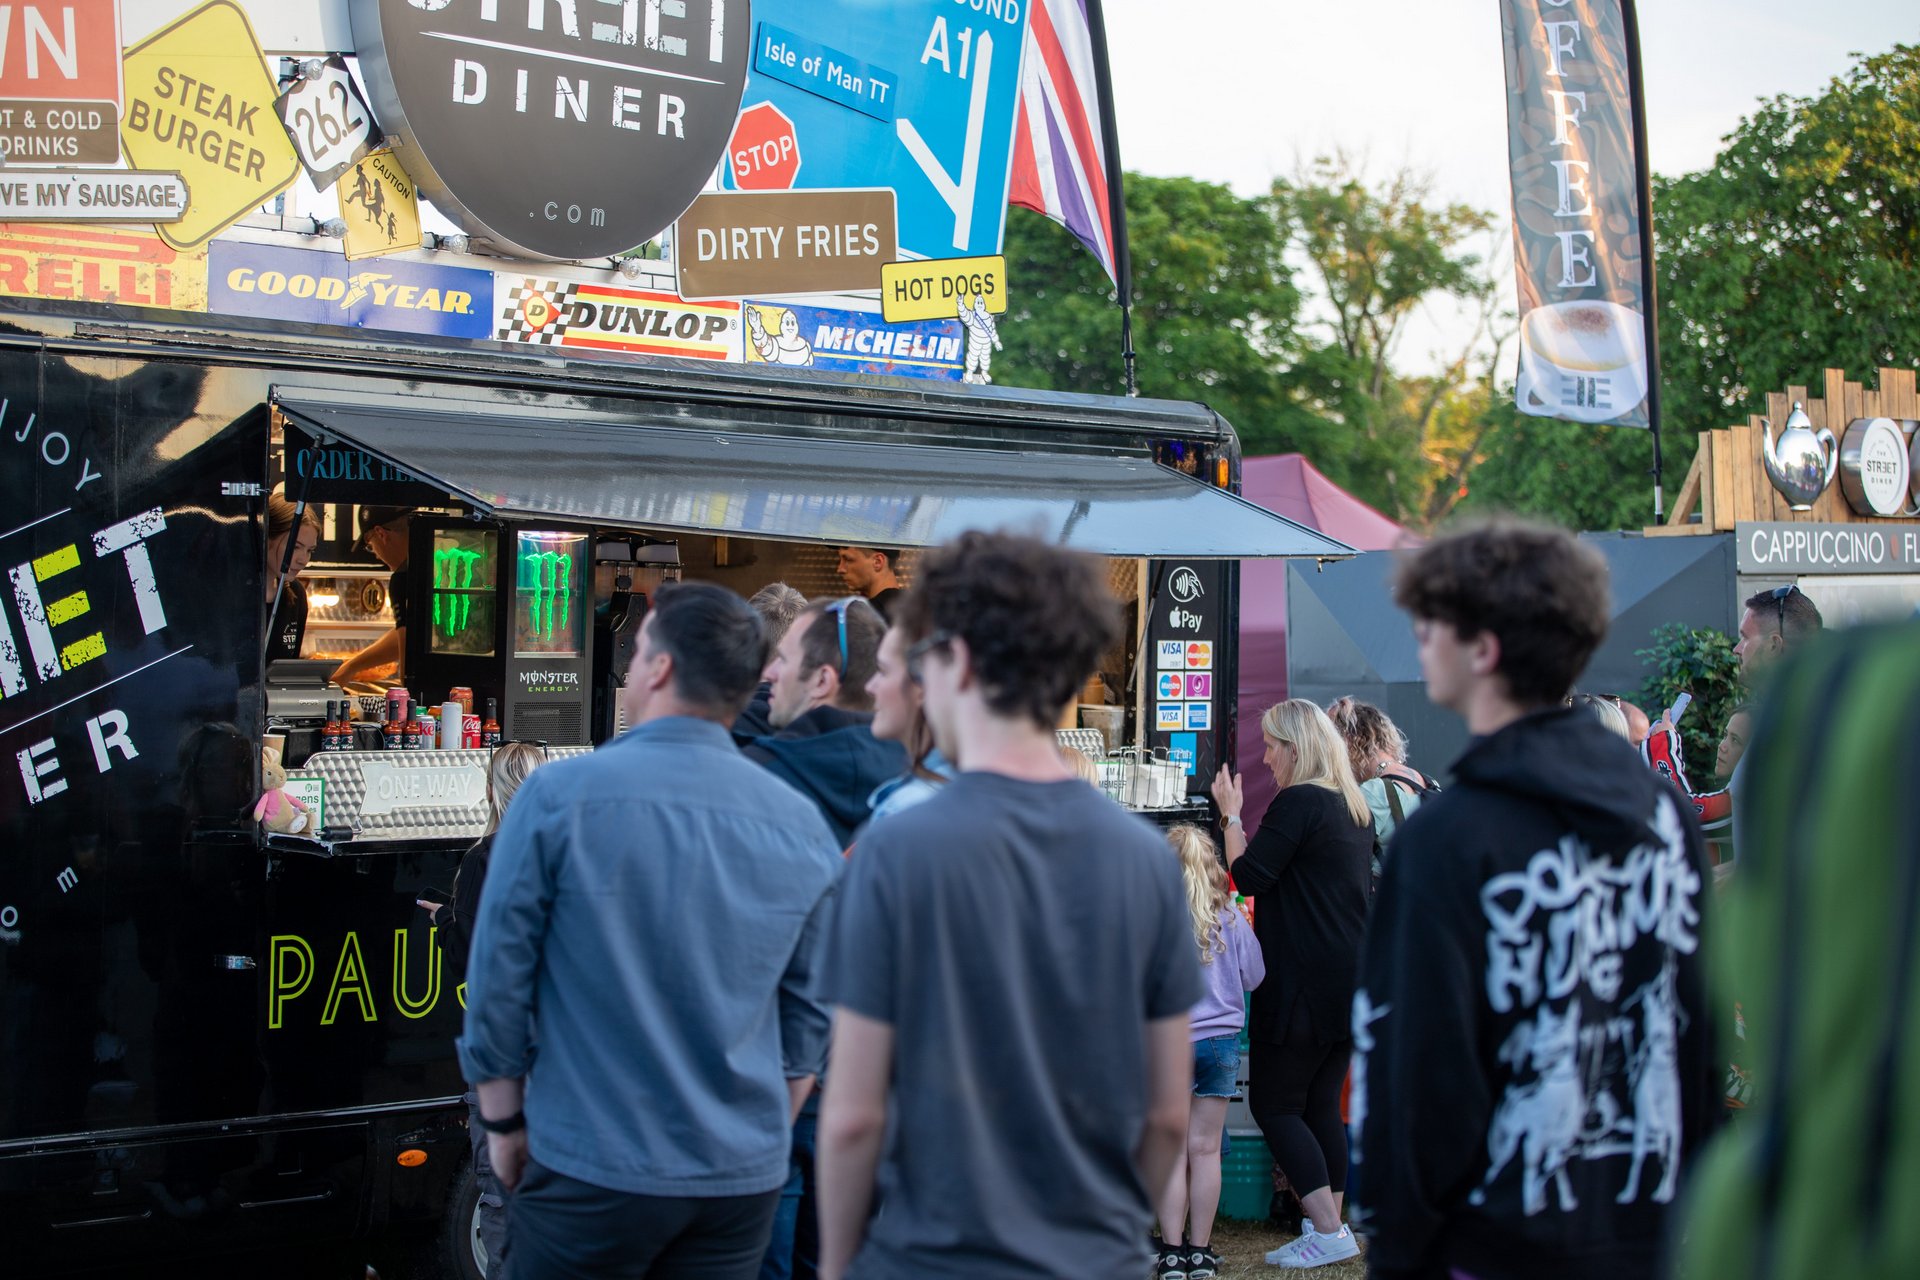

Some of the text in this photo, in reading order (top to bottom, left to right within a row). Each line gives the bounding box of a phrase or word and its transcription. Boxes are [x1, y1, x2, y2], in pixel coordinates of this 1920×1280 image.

[0, 5, 78, 80] N
[920, 15, 972, 80] A1
[764, 37, 890, 104] Isle of Man TT
[153, 66, 260, 137] STEAK
[452, 58, 686, 140] DINER
[24, 110, 36, 129] &
[46, 110, 101, 130] COLD
[128, 98, 266, 183] BURGER
[735, 135, 793, 178] STOP
[1542, 0, 1597, 289] FFEE
[36, 183, 71, 207] MY
[79, 183, 178, 208] SAUSAGE
[372, 157, 411, 200] CAUTION
[530, 201, 606, 228] .com
[697, 223, 880, 262] DIRTY FRIES
[894, 273, 995, 302] HOT DOGS
[566, 301, 728, 342] DUNLOP
[813, 326, 961, 361] MICHELIN
[296, 448, 375, 482] ORDER
[1871, 477, 1893, 486] DINER
[1750, 529, 1885, 565] CAPPUCCINO
[1181, 610, 1203, 633] Pay
[1161, 642, 1182, 655] VISA
[519, 670, 579, 685] MONSTER
[1161, 711, 1179, 721] VISA
[378, 773, 473, 800] ONE WAY
[268, 926, 468, 1029] PAU
